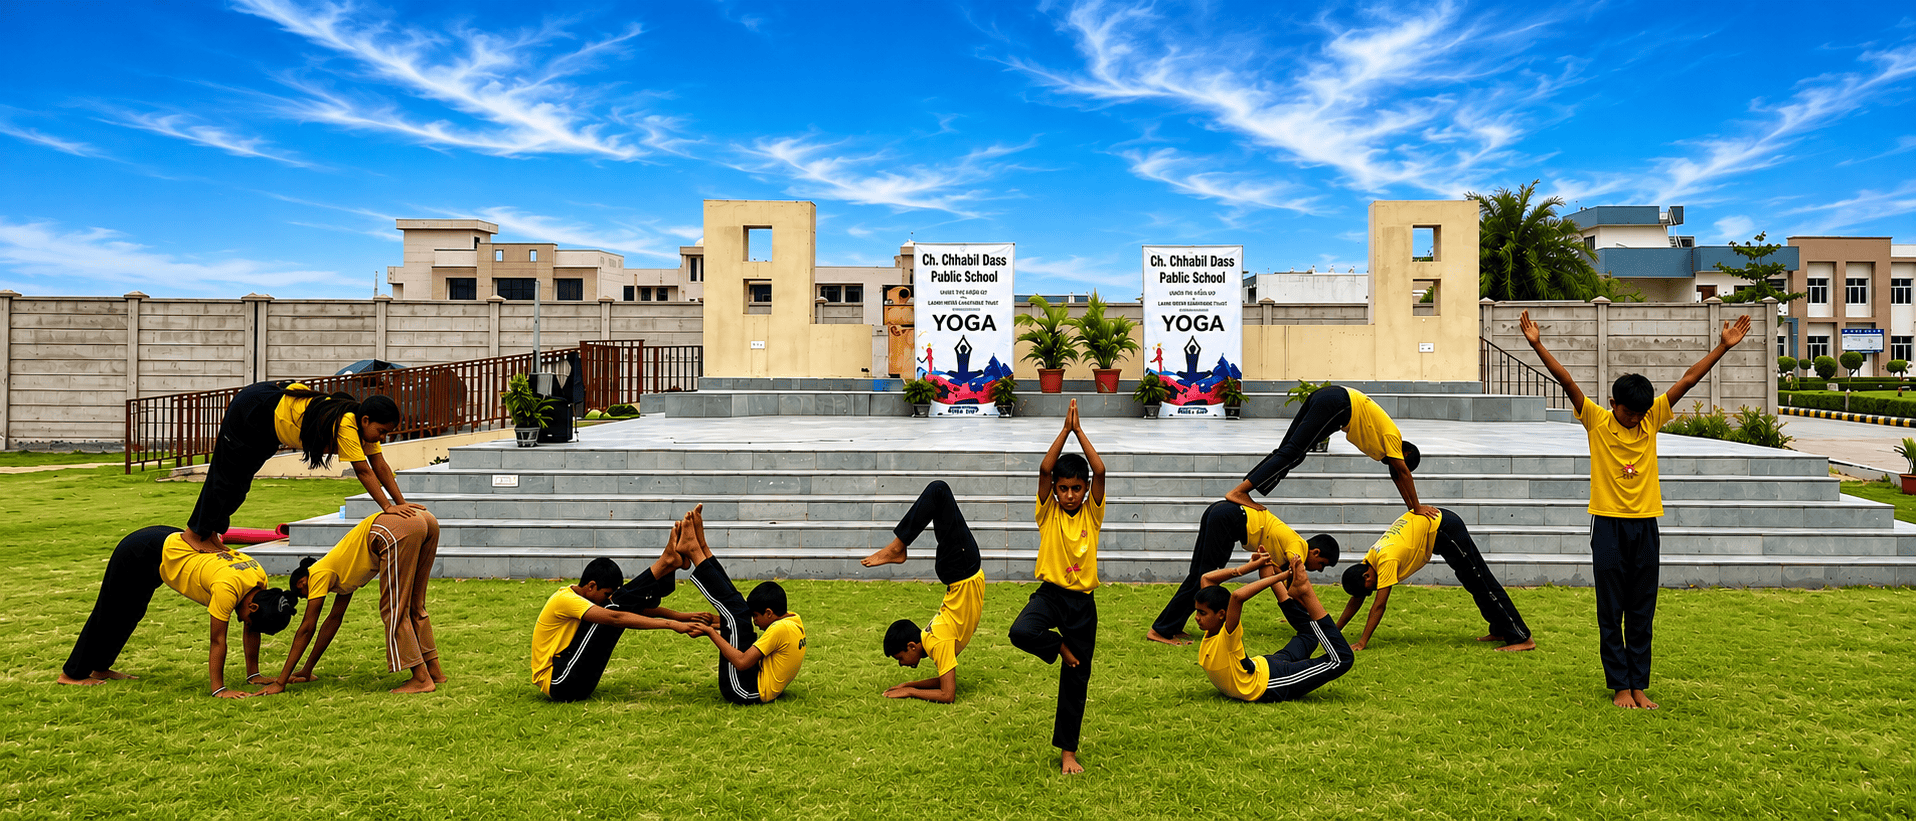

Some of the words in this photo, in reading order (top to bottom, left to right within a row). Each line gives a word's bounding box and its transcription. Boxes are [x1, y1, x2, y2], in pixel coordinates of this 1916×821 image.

[922, 253, 939, 266] Ch.
[941, 253, 979, 266] Chhabil
[983, 253, 1007, 266] Dass
[1150, 255, 1167, 267] Ch.
[1169, 255, 1207, 267] Chhabil
[1210, 255, 1235, 267] Dass
[931, 270, 962, 282] Public
[964, 270, 998, 282] School
[1192, 271, 1226, 283] School
[932, 314, 997, 331] YOGA
[1161, 315, 1225, 332] YOGA
